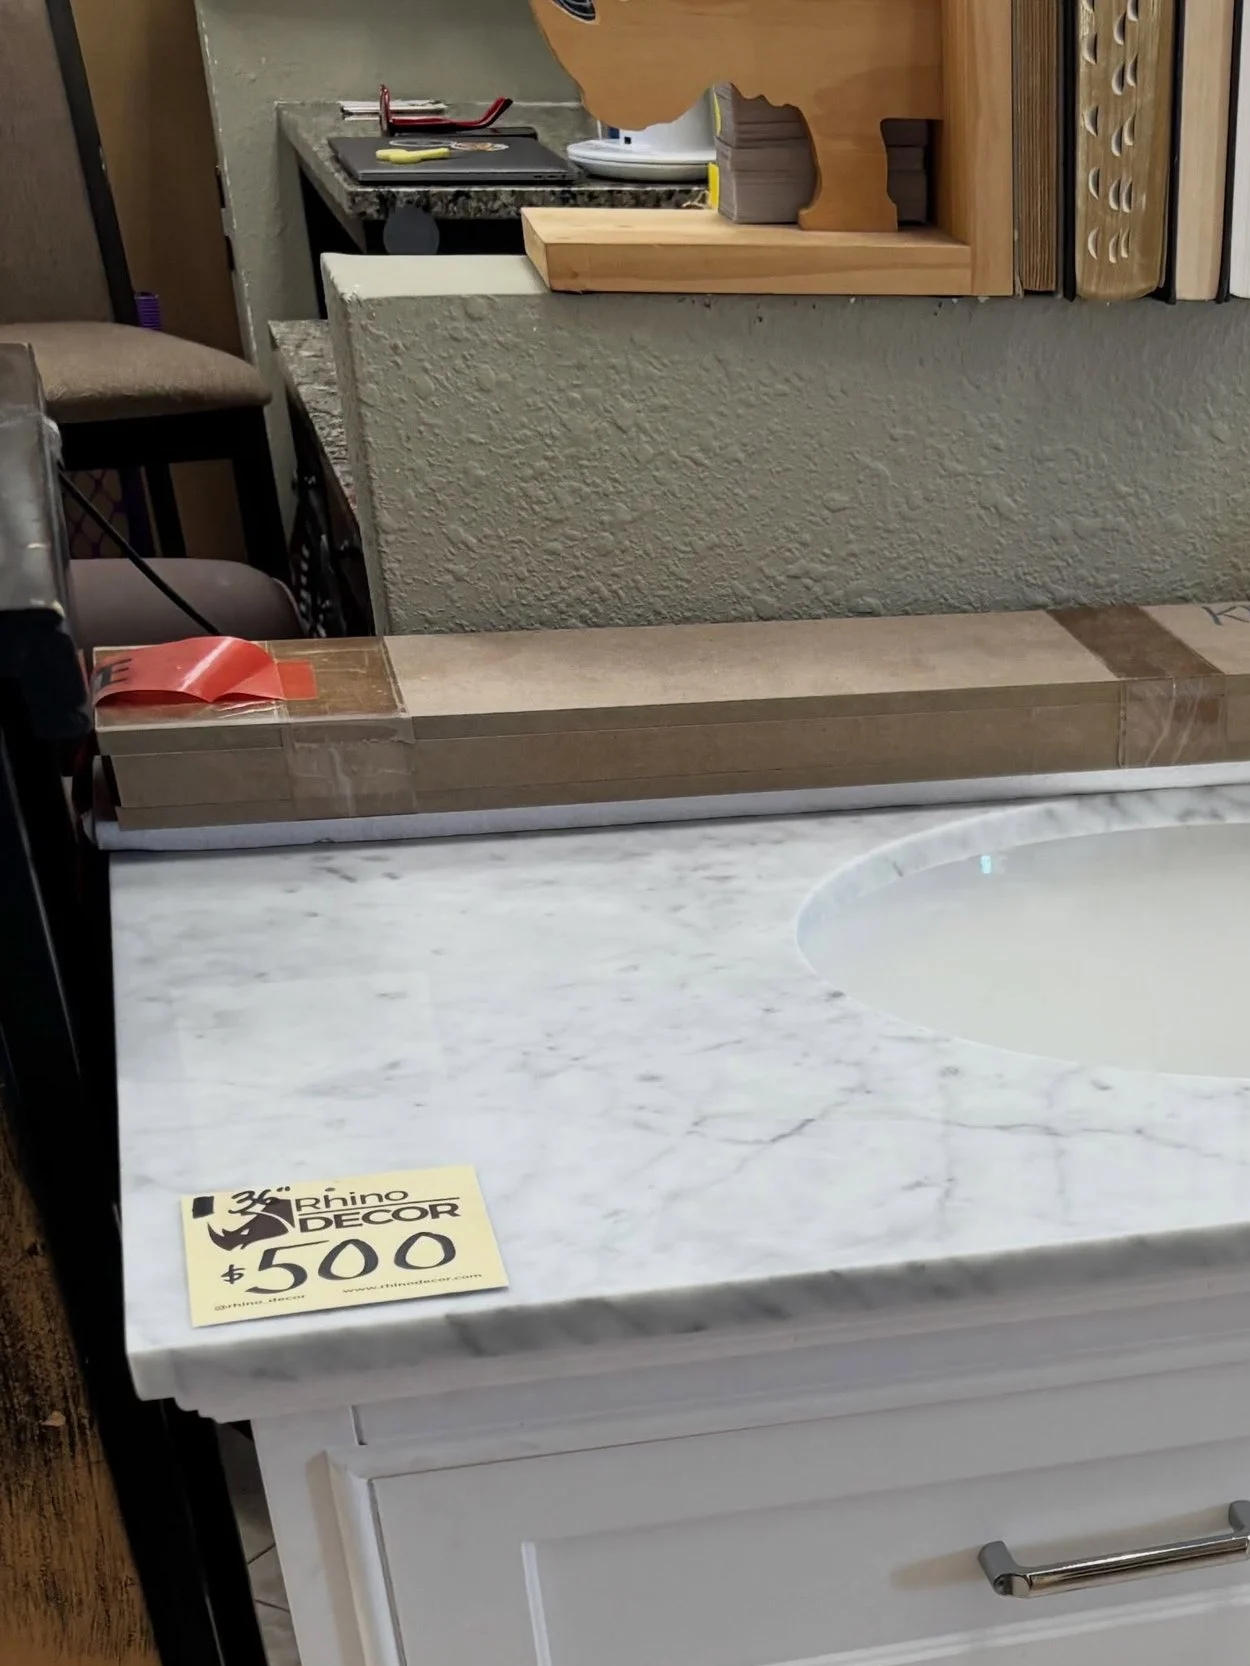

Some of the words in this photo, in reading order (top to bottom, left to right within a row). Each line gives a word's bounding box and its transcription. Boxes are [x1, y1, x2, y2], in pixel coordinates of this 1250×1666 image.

[295, 1187, 409, 1212] Rhino
[298, 1202, 461, 1233] DECOR
[220, 1231, 457, 1295] $500
